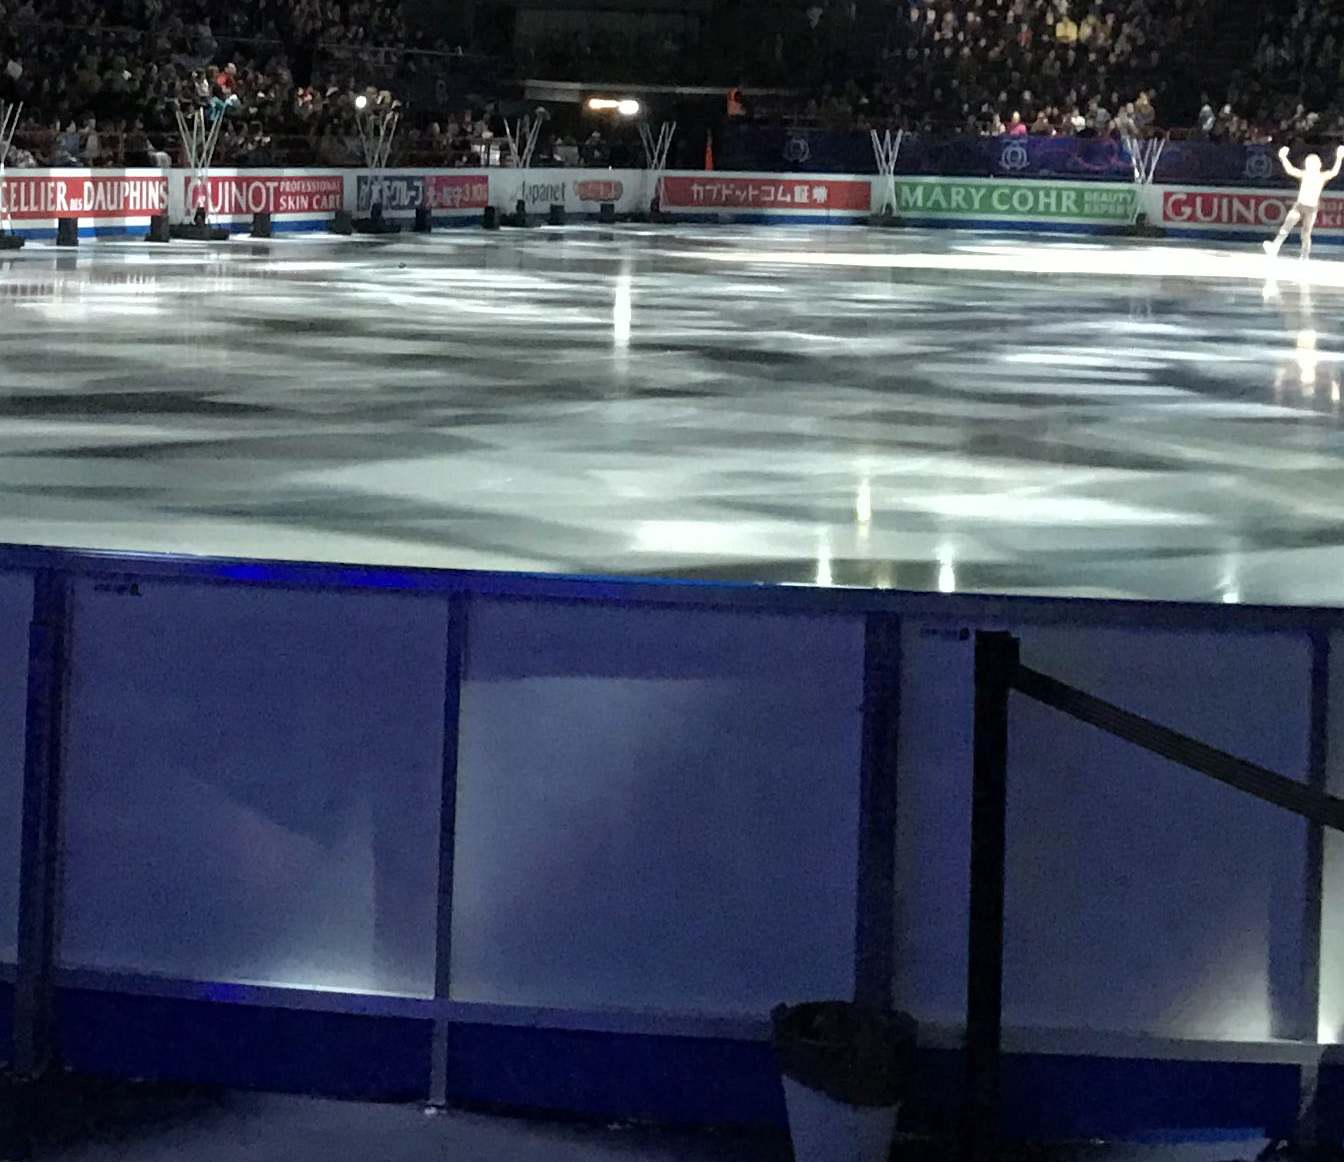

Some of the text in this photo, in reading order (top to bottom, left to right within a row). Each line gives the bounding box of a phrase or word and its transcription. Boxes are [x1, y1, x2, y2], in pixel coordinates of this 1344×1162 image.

[83, 180, 168, 212] DAUPHINS
[280, 193, 341, 211] SKIN CARE
[900, 185, 1079, 217] MARY COHR
[1164, 192, 1296, 226] GUINO
